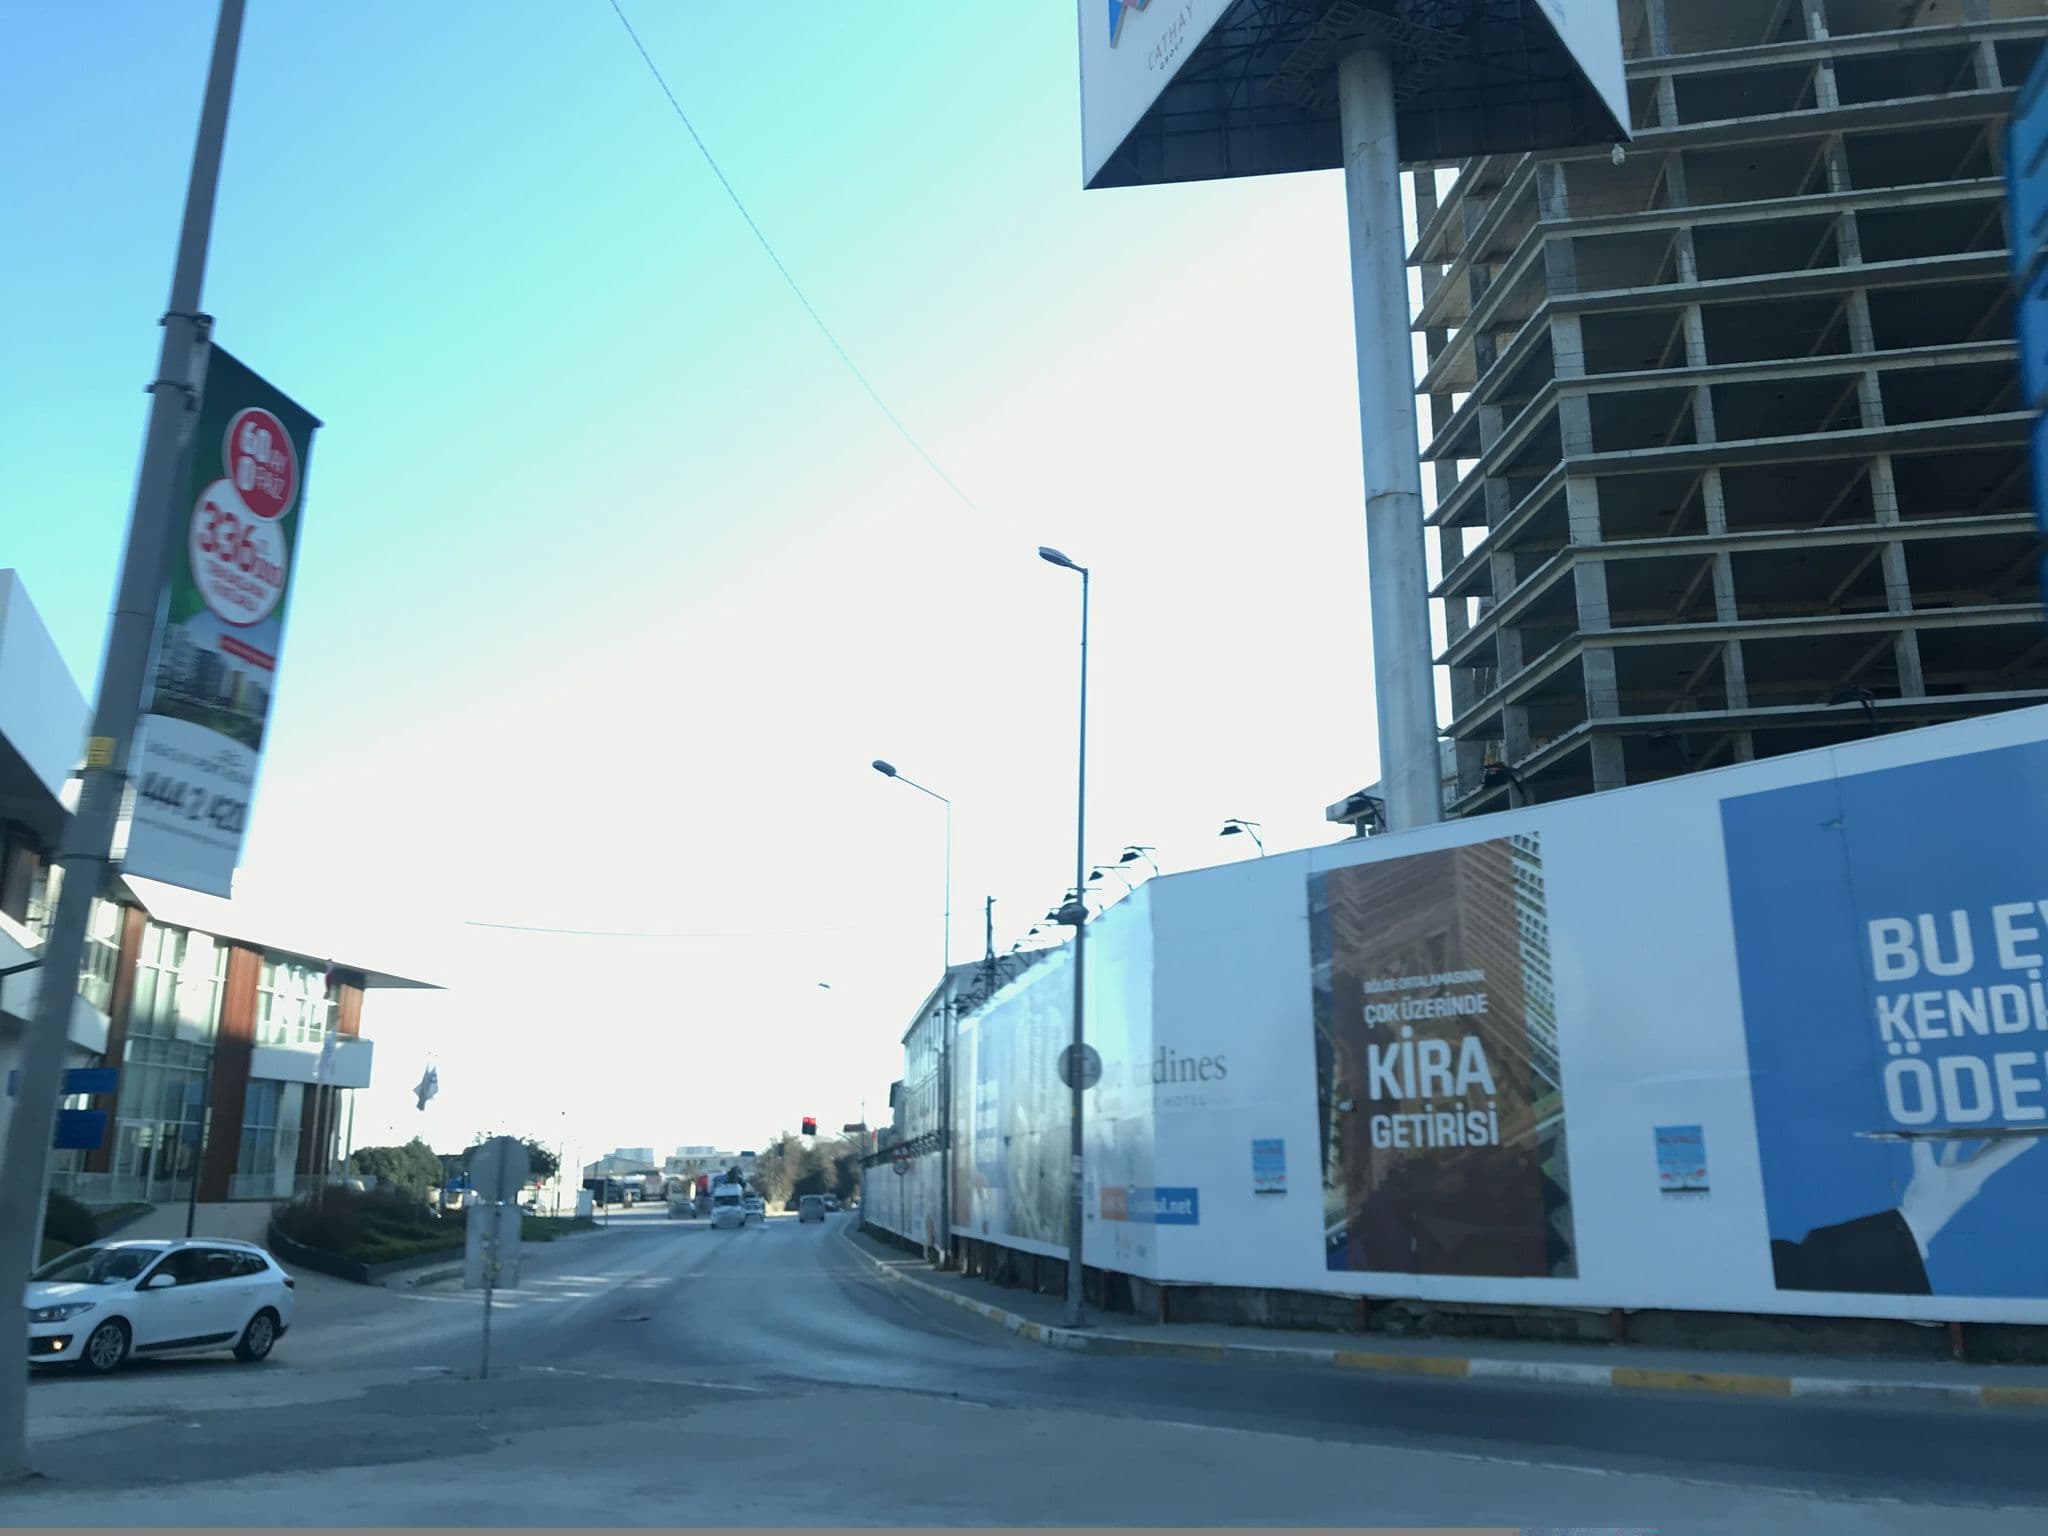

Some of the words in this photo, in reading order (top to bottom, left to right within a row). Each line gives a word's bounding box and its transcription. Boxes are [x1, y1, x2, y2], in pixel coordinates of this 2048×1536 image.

[1148, 0, 1194, 71] CATHAY
[200, 502, 257, 573] 336
[1868, 909, 1975, 982] BU
[1992, 900, 2048, 970] E
[1364, 1003, 1400, 1029] ÇOK
[1401, 992, 1489, 1020] ÜZERİNDE
[1876, 968, 2048, 1042] KENDİ
[1367, 1025, 1497, 1100] KİRA
[1884, 1040, 2048, 1125] ÖDE
[1370, 1101, 1500, 1149] GETİRİSİ
